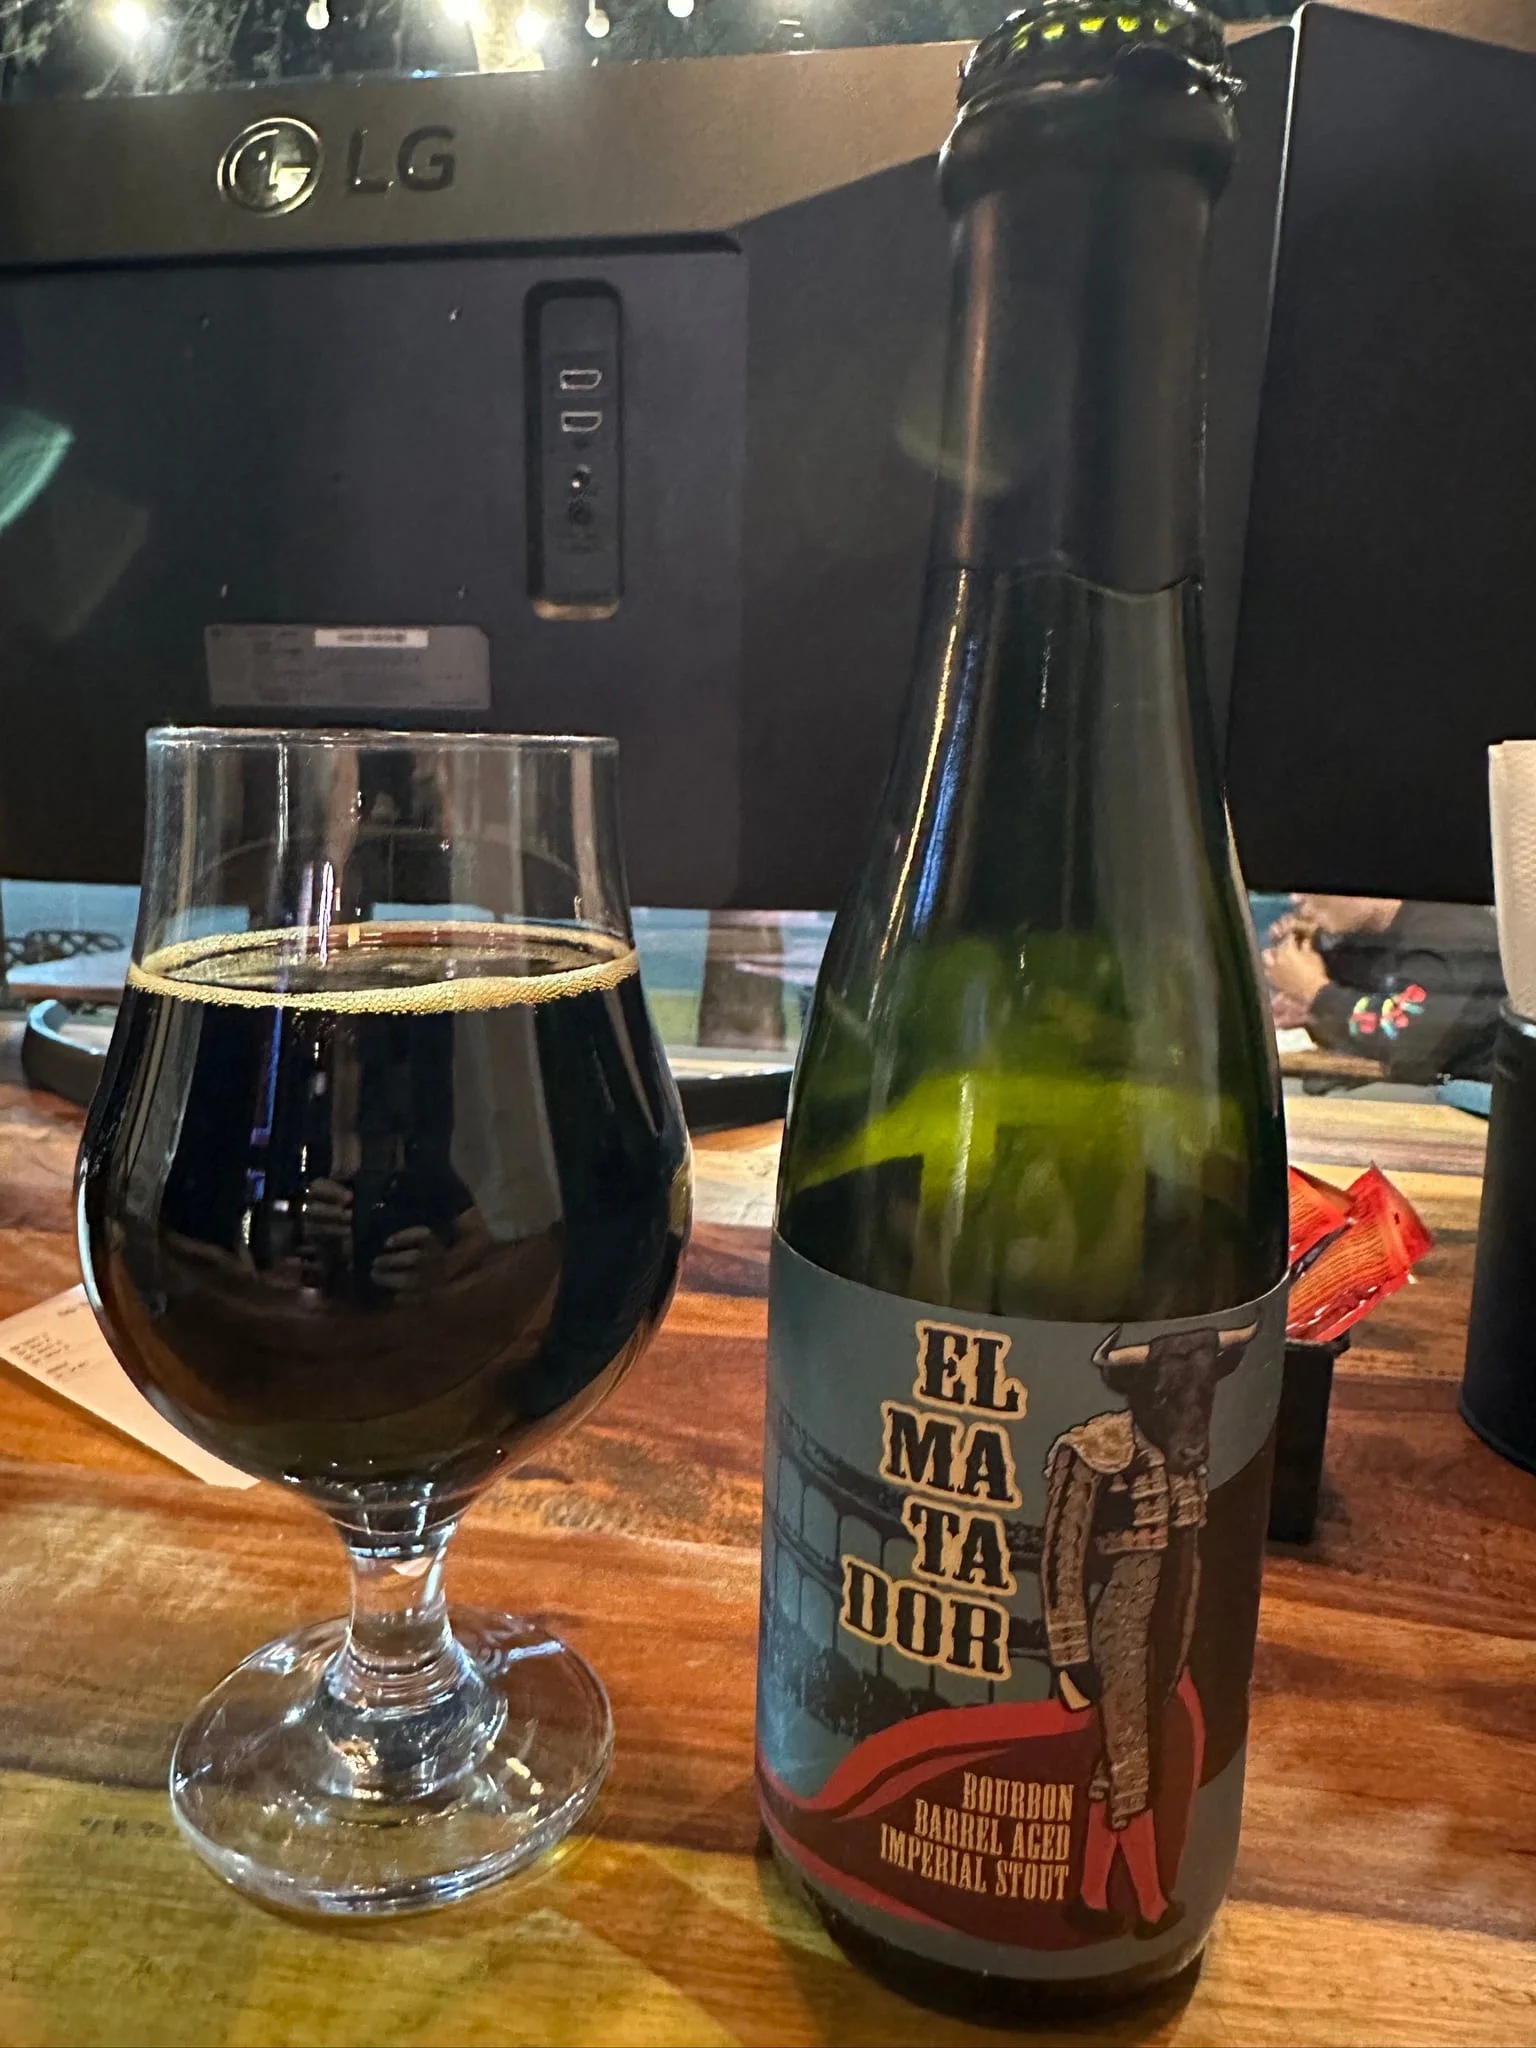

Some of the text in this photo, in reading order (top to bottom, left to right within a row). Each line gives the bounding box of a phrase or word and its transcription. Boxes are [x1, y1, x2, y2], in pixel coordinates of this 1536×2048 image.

[347, 124, 457, 194] LG
[916, 1324, 1023, 1415] EL
[883, 1404, 1018, 1505] MA
[906, 1500, 1013, 1593] TA
[843, 1557, 1008, 1677] DOR
[914, 1798, 1071, 1861] BARREL AGED
[961, 1771, 1074, 1822] BOURBON
[879, 1822, 1070, 1901] IMPERIAL STOUT
